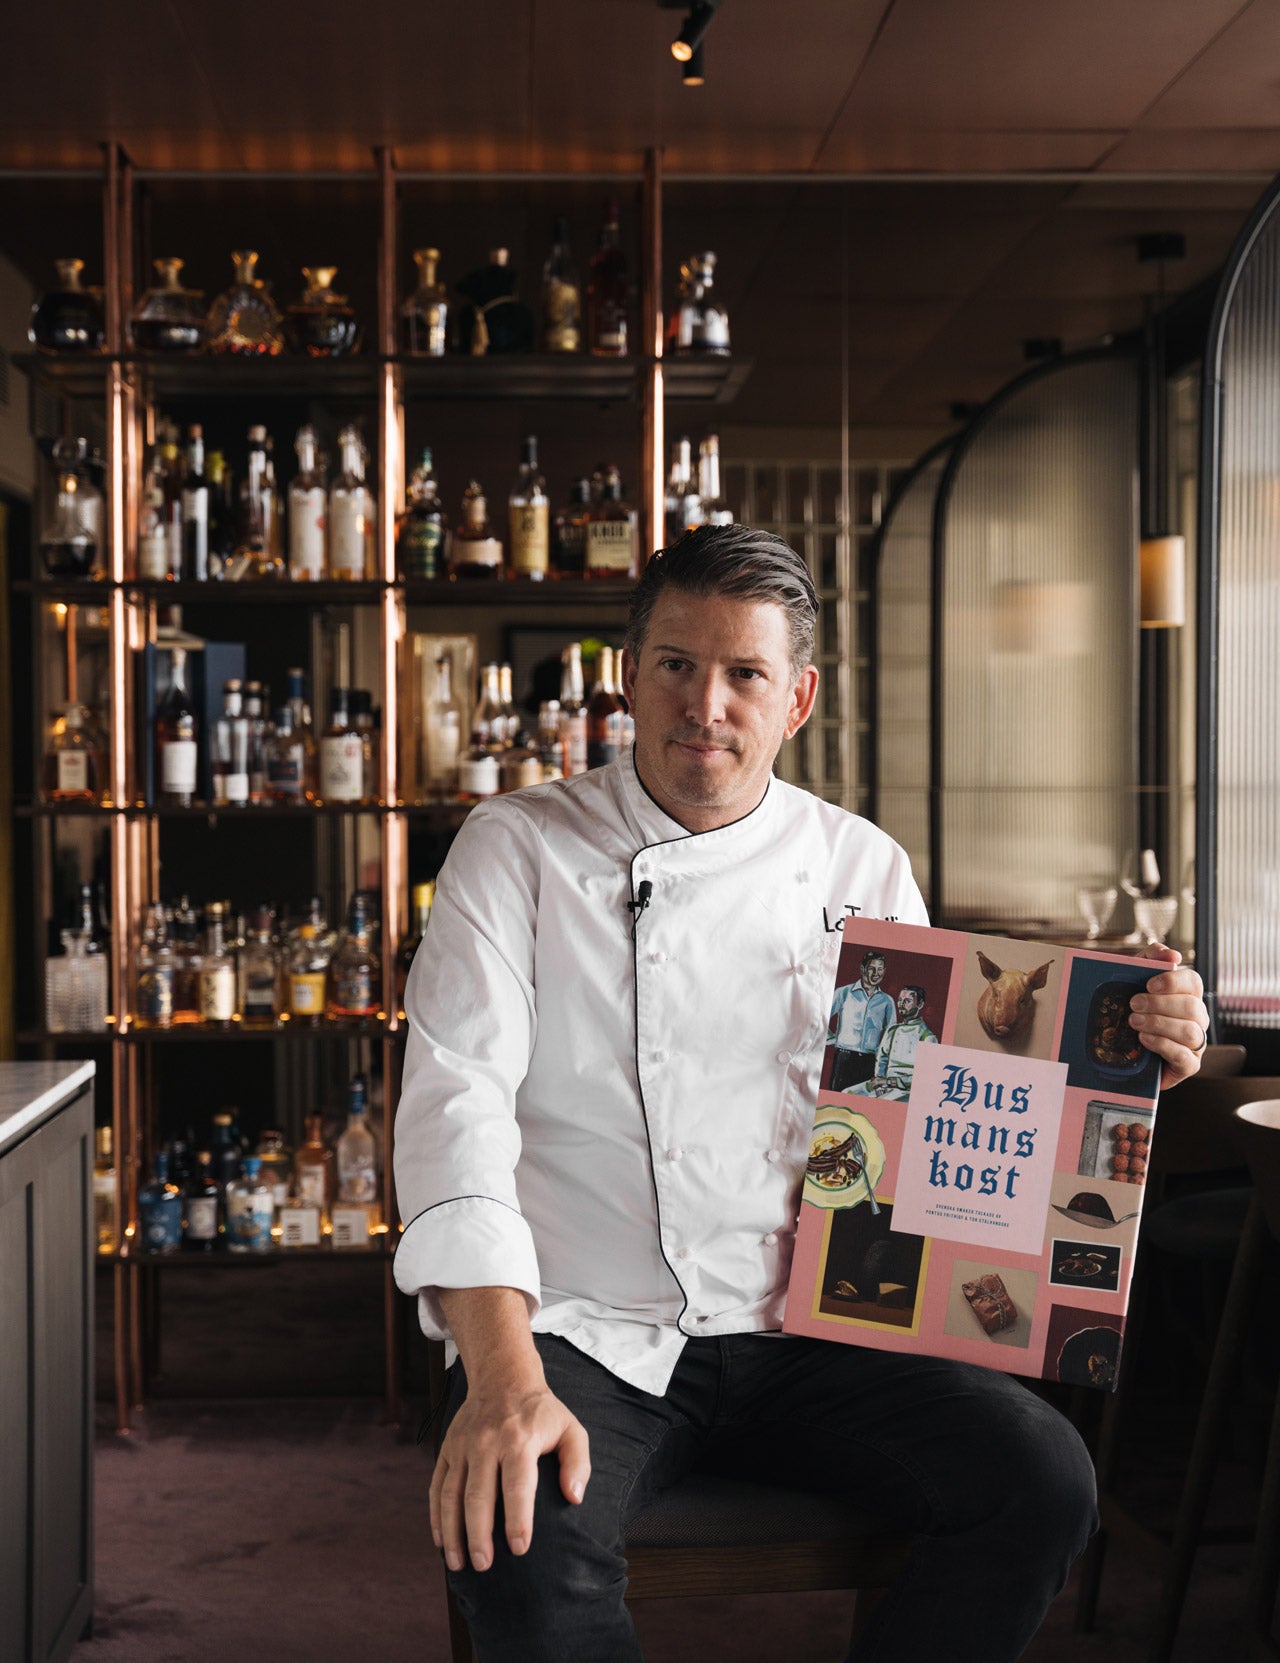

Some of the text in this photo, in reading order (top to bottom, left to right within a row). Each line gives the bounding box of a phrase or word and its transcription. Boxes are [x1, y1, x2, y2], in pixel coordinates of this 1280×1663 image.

[938, 1064, 1033, 1115] Hus
[923, 1115, 1038, 1158] mans
[928, 1150, 1020, 1199] kost
[925, 1209, 942, 1217] PONTUS
